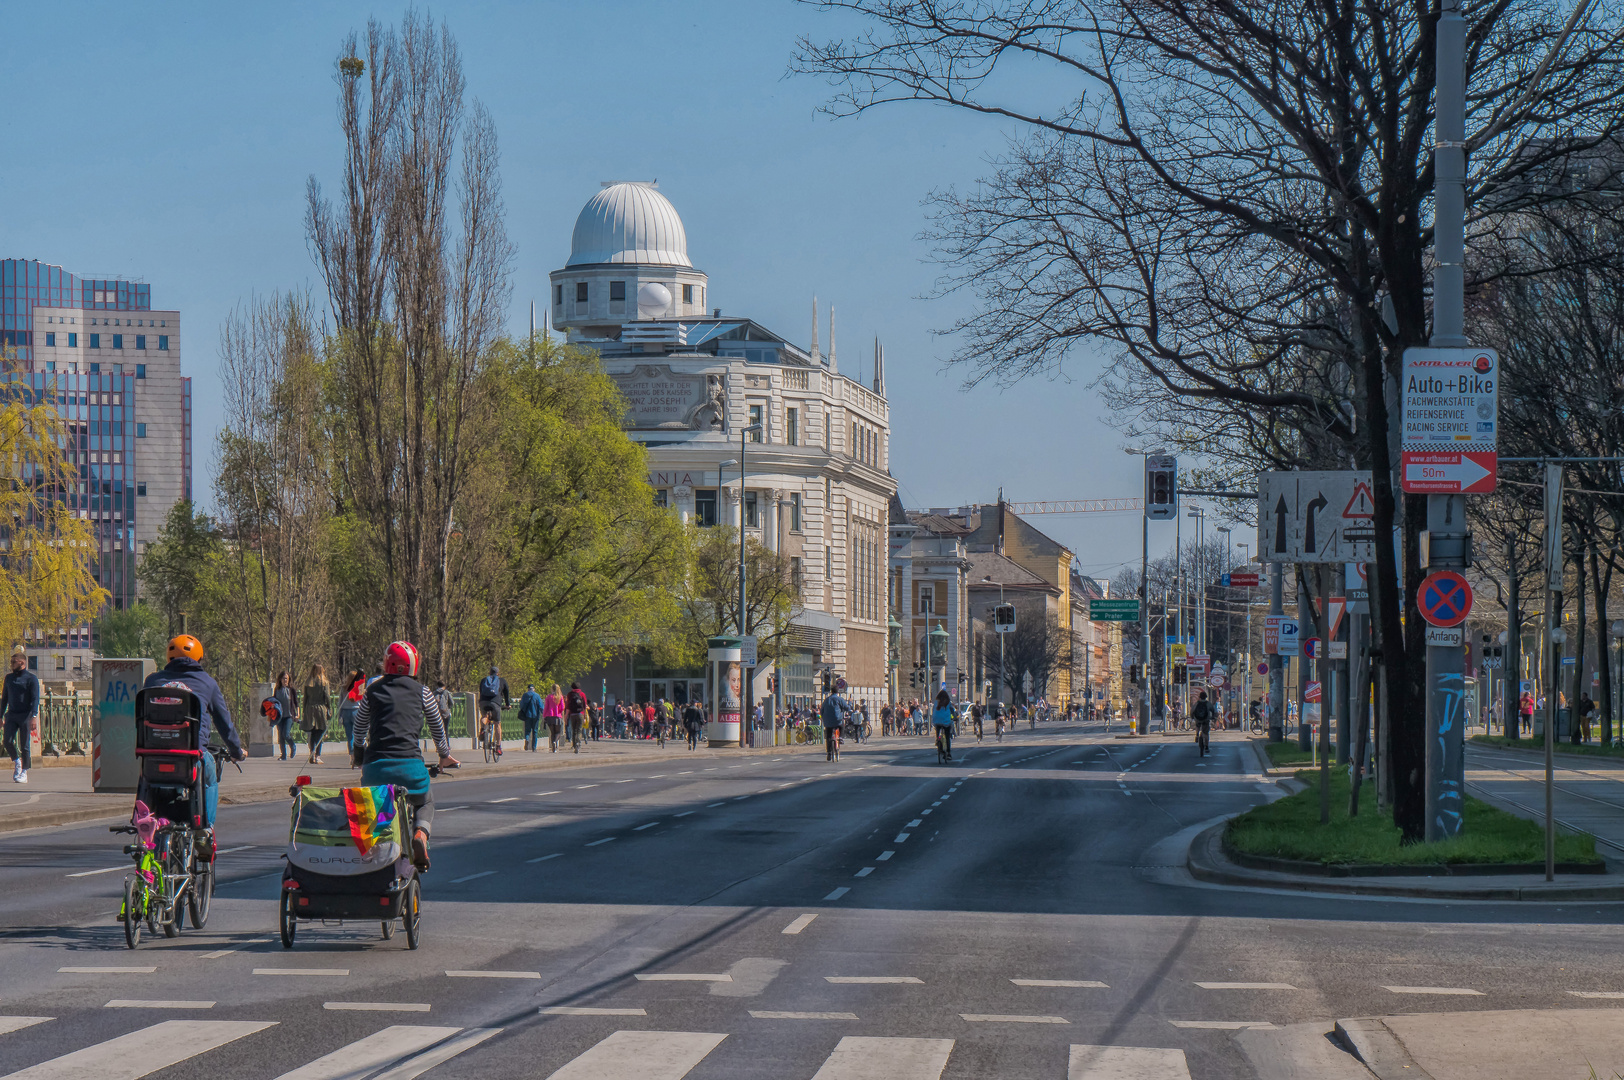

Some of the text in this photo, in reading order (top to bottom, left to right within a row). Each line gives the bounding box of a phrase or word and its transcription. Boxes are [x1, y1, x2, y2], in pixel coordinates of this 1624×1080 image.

[1407, 374, 1493, 393] Auto+Bike
[1407, 396, 1475, 406] FACHWERKSTÄTTE
[1407, 409, 1465, 419] REIFENSERVICE
[1406, 422, 1434, 432] RACING
[1437, 422, 1468, 432] SERVICE
[1422, 467, 1446, 478] 50m
[105, 681, 130, 702] AFA
